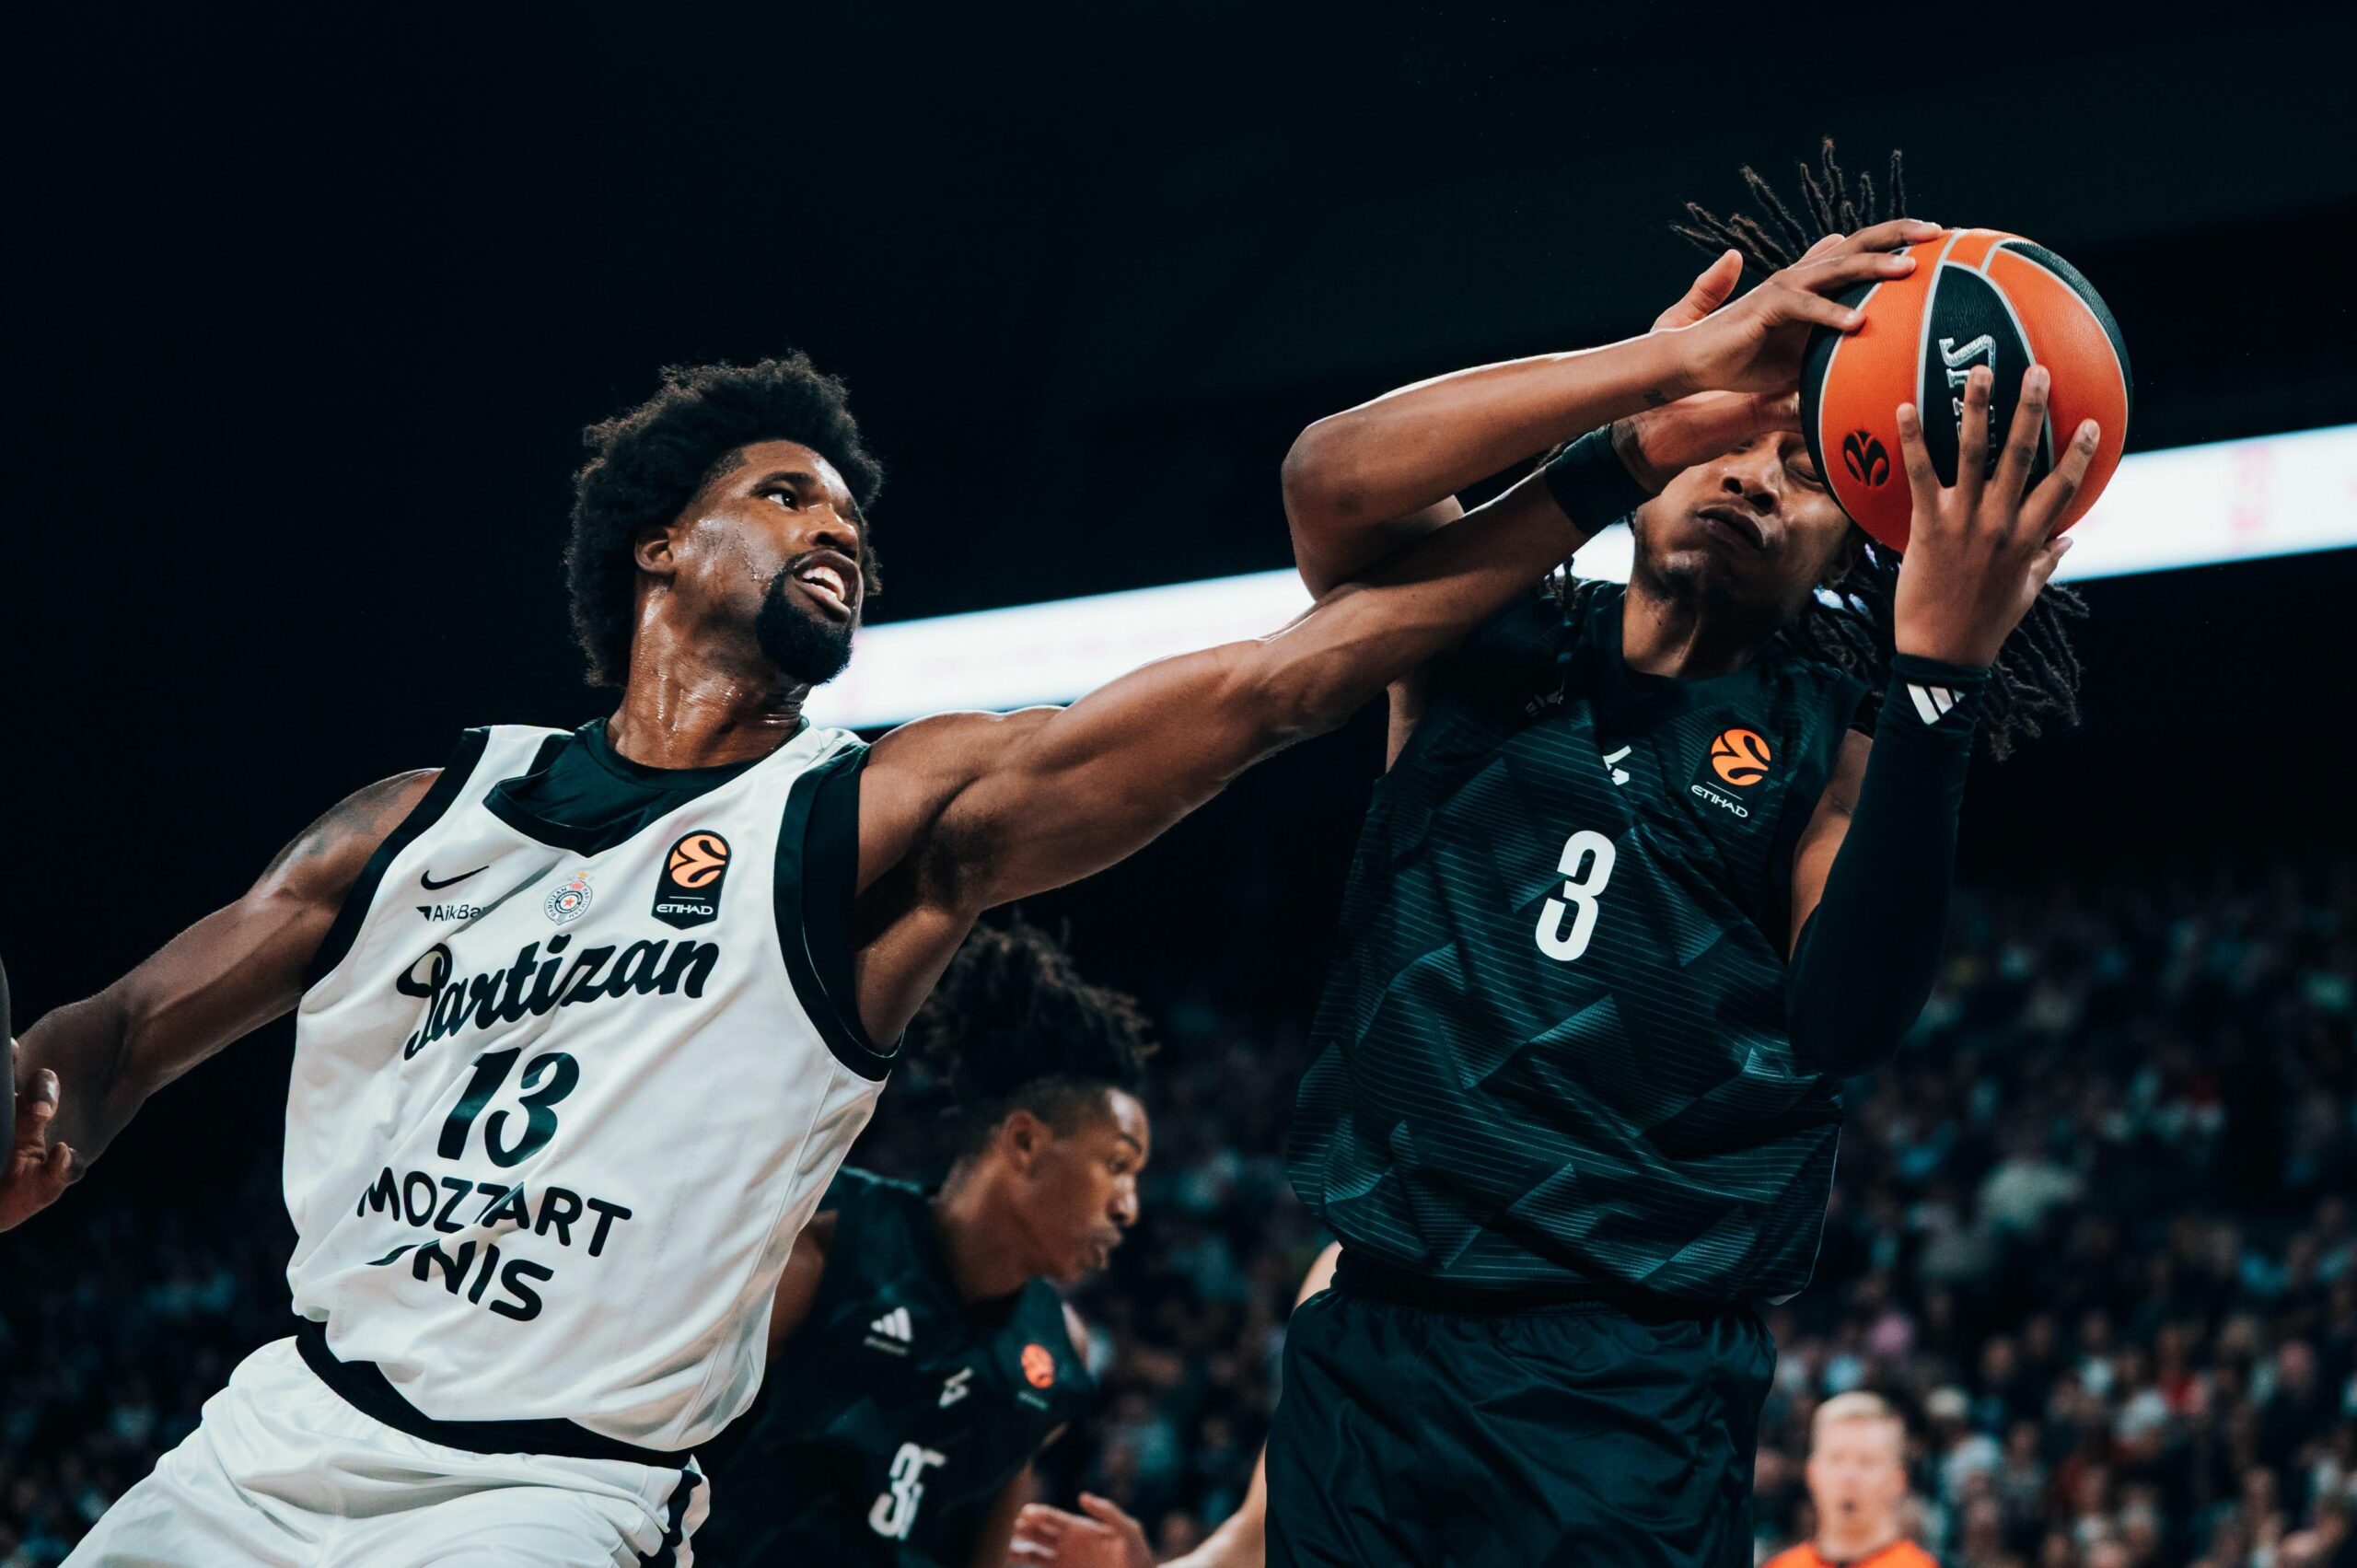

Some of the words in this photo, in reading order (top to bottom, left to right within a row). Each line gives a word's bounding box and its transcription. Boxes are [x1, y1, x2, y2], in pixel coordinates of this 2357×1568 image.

[1691, 784, 1748, 818] ETIHAD
[432, 904, 486, 922] AikBa
[656, 903, 714, 915] ETIHAD
[1535, 830, 1617, 961] 3
[396, 934, 720, 1061] Partizan
[437, 1047, 580, 1168] 13
[356, 1167, 633, 1258] MOZZART
[366, 1238, 554, 1322] NIS
